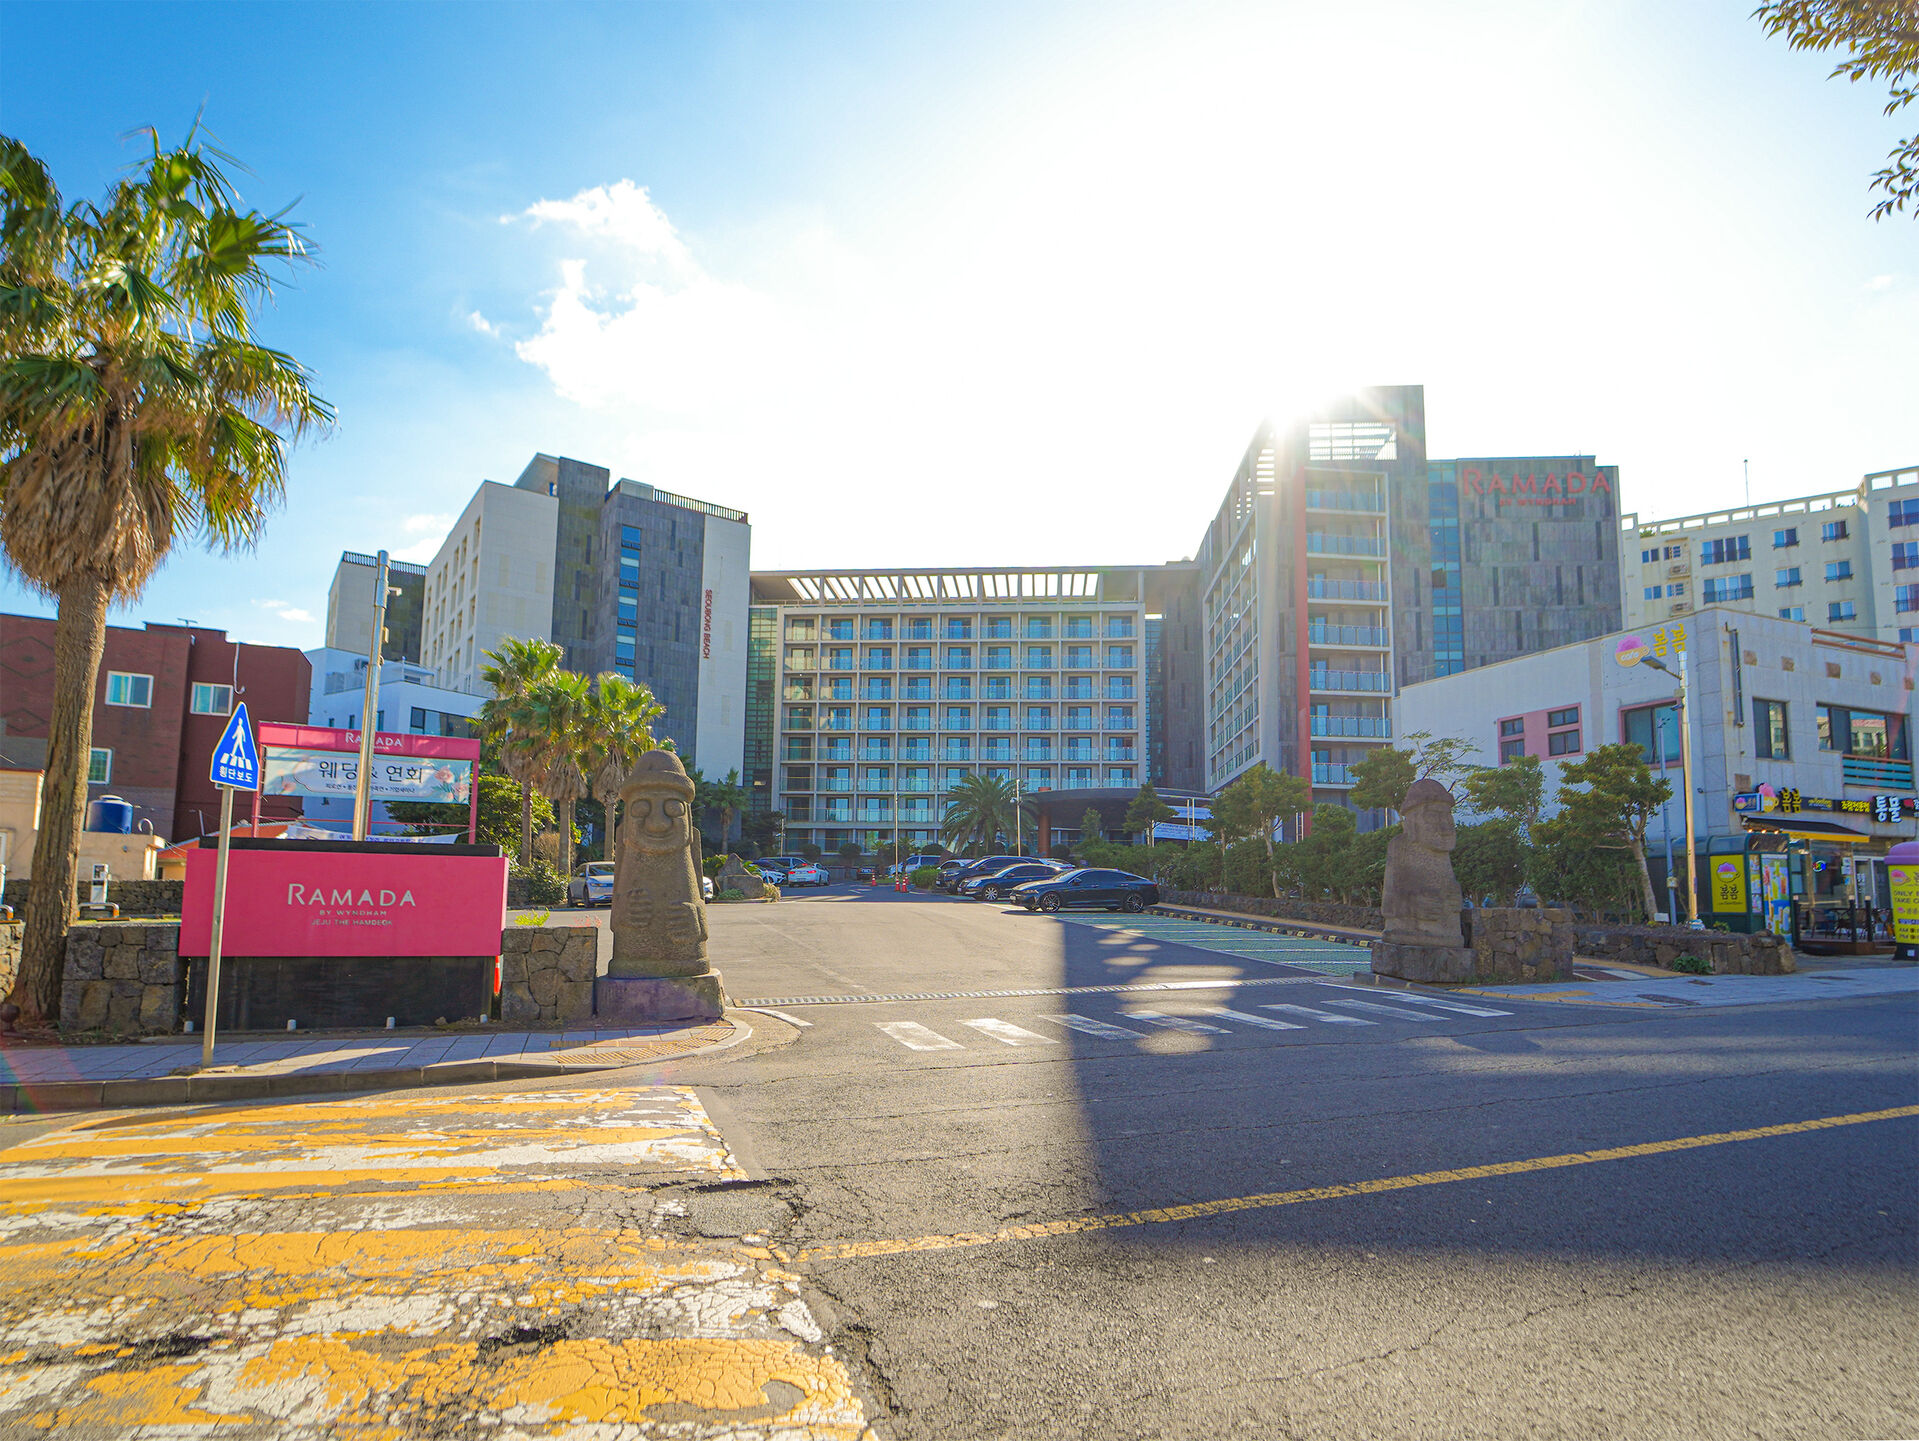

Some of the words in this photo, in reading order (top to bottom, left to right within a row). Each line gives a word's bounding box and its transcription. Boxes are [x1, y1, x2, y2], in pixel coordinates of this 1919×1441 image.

[1462, 468, 1611, 496] RAMADA
[1499, 498, 1512, 507] BY
[1517, 497, 1577, 506] WYNDHAM
[703, 633, 711, 660] BEACH
[1652, 623, 1688, 657] 봄봄
[345, 732, 403, 747] RAADA
[219, 765, 253, 783] 횡단보도
[318, 760, 358, 780] 웨딩
[385, 765, 424, 784] 연회
[1781, 787, 1802, 813] 봄봄
[287, 883, 417, 907] RAMADA
[311, 918, 332, 926] JEJU
